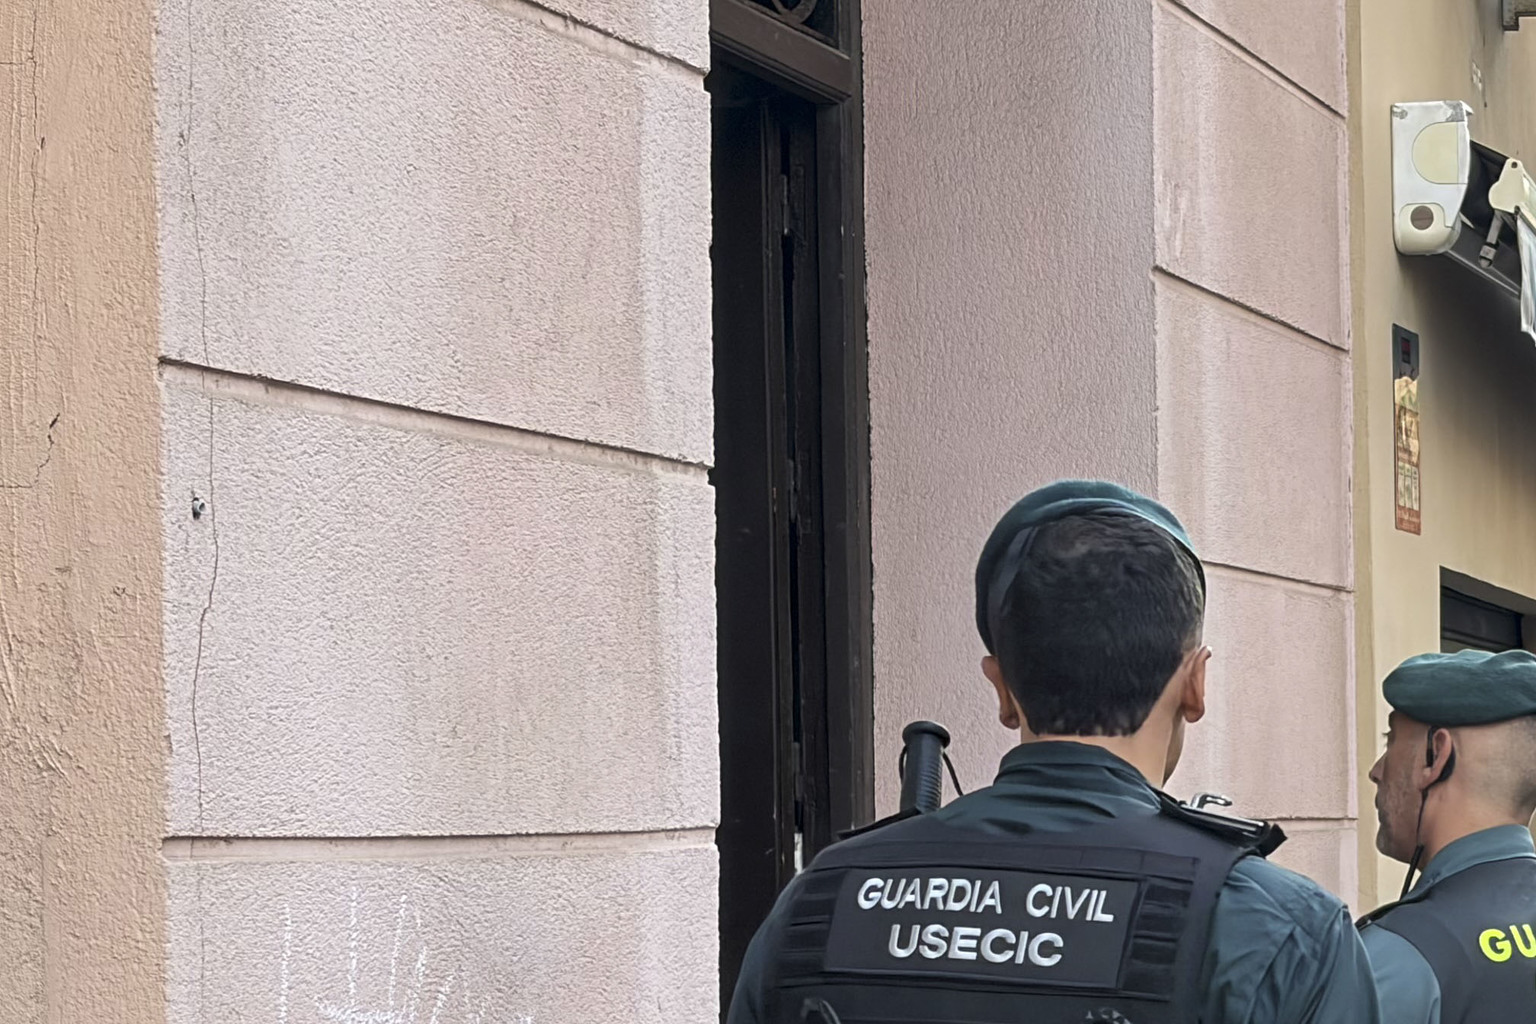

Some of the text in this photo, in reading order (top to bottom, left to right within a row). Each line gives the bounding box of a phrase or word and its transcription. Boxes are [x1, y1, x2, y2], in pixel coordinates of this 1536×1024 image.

[857, 877, 1114, 922] GUARDIA CIVIL
[889, 923, 1064, 967] USECIC
